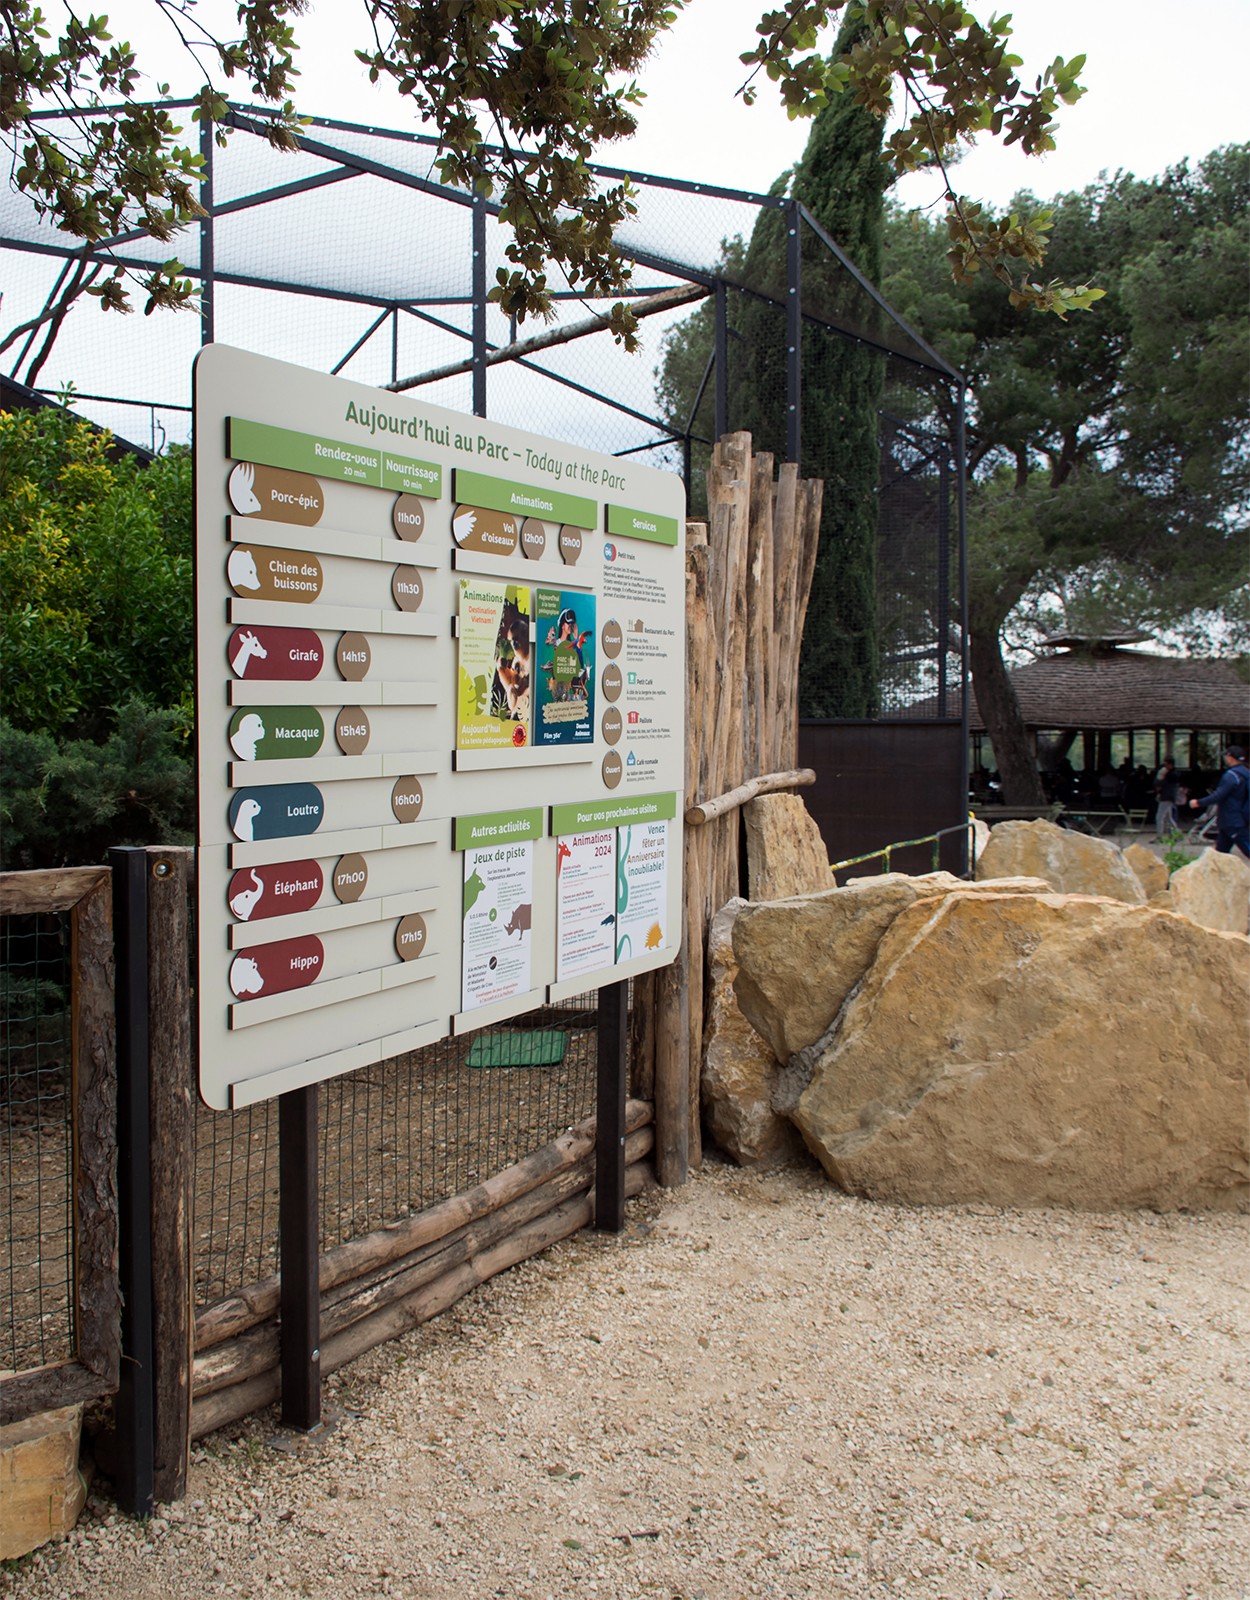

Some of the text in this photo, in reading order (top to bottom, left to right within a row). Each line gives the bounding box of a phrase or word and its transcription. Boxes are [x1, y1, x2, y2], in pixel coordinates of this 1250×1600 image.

[345, 401, 450, 446] Aujourd'hui
[454, 434, 472, 452] au
[478, 436, 509, 461] Parc
[526, 449, 562, 480] Today
[566, 462, 578, 478] at
[581, 464, 598, 484] the
[602, 470, 626, 490] Parc
[315, 443, 377, 468] Rendez-vous
[344, 467, 366, 478] 20 min
[386, 460, 438, 483] Nourrissage
[403, 478, 422, 490] 10 min
[271, 490, 318, 509] Porc-épic
[510, 492, 552, 511] Animations
[398, 512, 421, 526] 11h00
[632, 518, 656, 532] Services
[503, 523, 514, 534] Vol
[482, 532, 514, 546] d'oiseaux
[524, 532, 544, 545] 12h00
[562, 536, 580, 548] 15h00
[269, 560, 318, 576] Chien des
[274, 576, 318, 592] buissons
[397, 582, 419, 594] 11h30
[464, 590, 502, 602] Animations
[468, 606, 496, 615] Destination
[605, 635, 620, 644] Ouvert
[290, 649, 318, 662] Girafe
[342, 652, 366, 662] 14h15
[275, 728, 319, 740] Macaque
[340, 726, 366, 736] 15h45
[395, 794, 420, 806] 16h00
[288, 804, 318, 816] Loutre
[577, 805, 658, 823] Pour vos prochaines visites
[471, 819, 530, 838] Autres activités
[648, 825, 665, 835] Venez
[572, 832, 612, 848] Animations
[642, 838, 665, 849] fêter un
[472, 846, 526, 865] Jeux de piste
[594, 846, 612, 857] 2024
[627, 849, 665, 864] Anniversaire
[337, 872, 365, 886] 17h00
[274, 878, 318, 896] Éléphant
[401, 930, 422, 944] 17h15
[290, 955, 318, 971] Hippo
